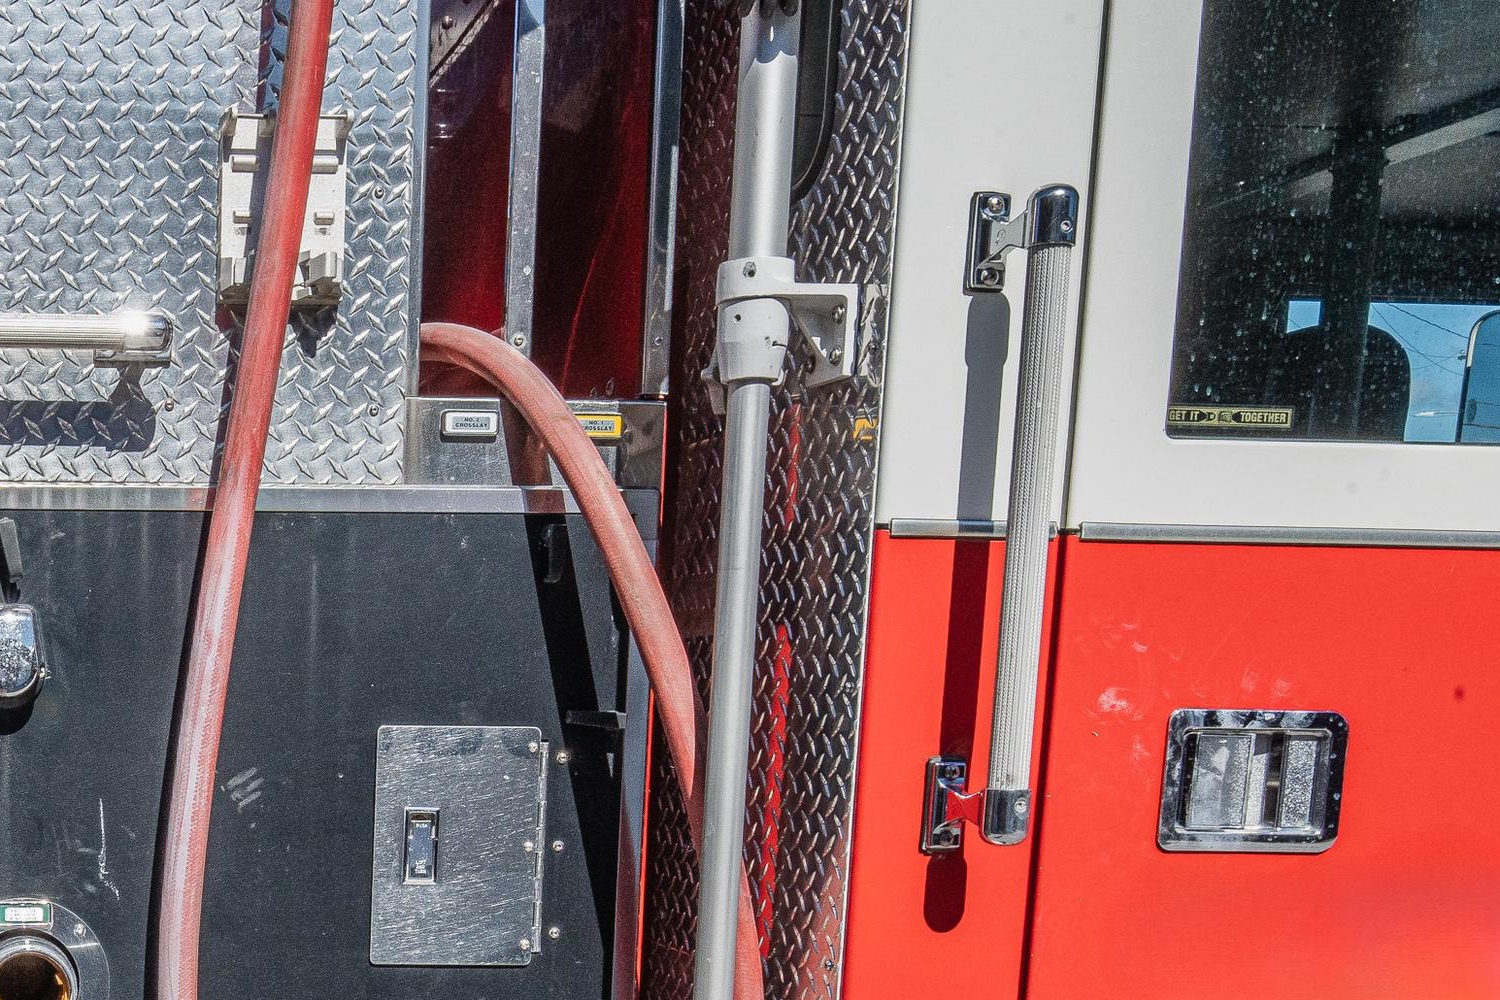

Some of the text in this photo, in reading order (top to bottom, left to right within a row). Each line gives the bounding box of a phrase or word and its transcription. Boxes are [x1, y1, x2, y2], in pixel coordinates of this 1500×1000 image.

[1169, 410, 1287, 423] GET IT TOGETHER
